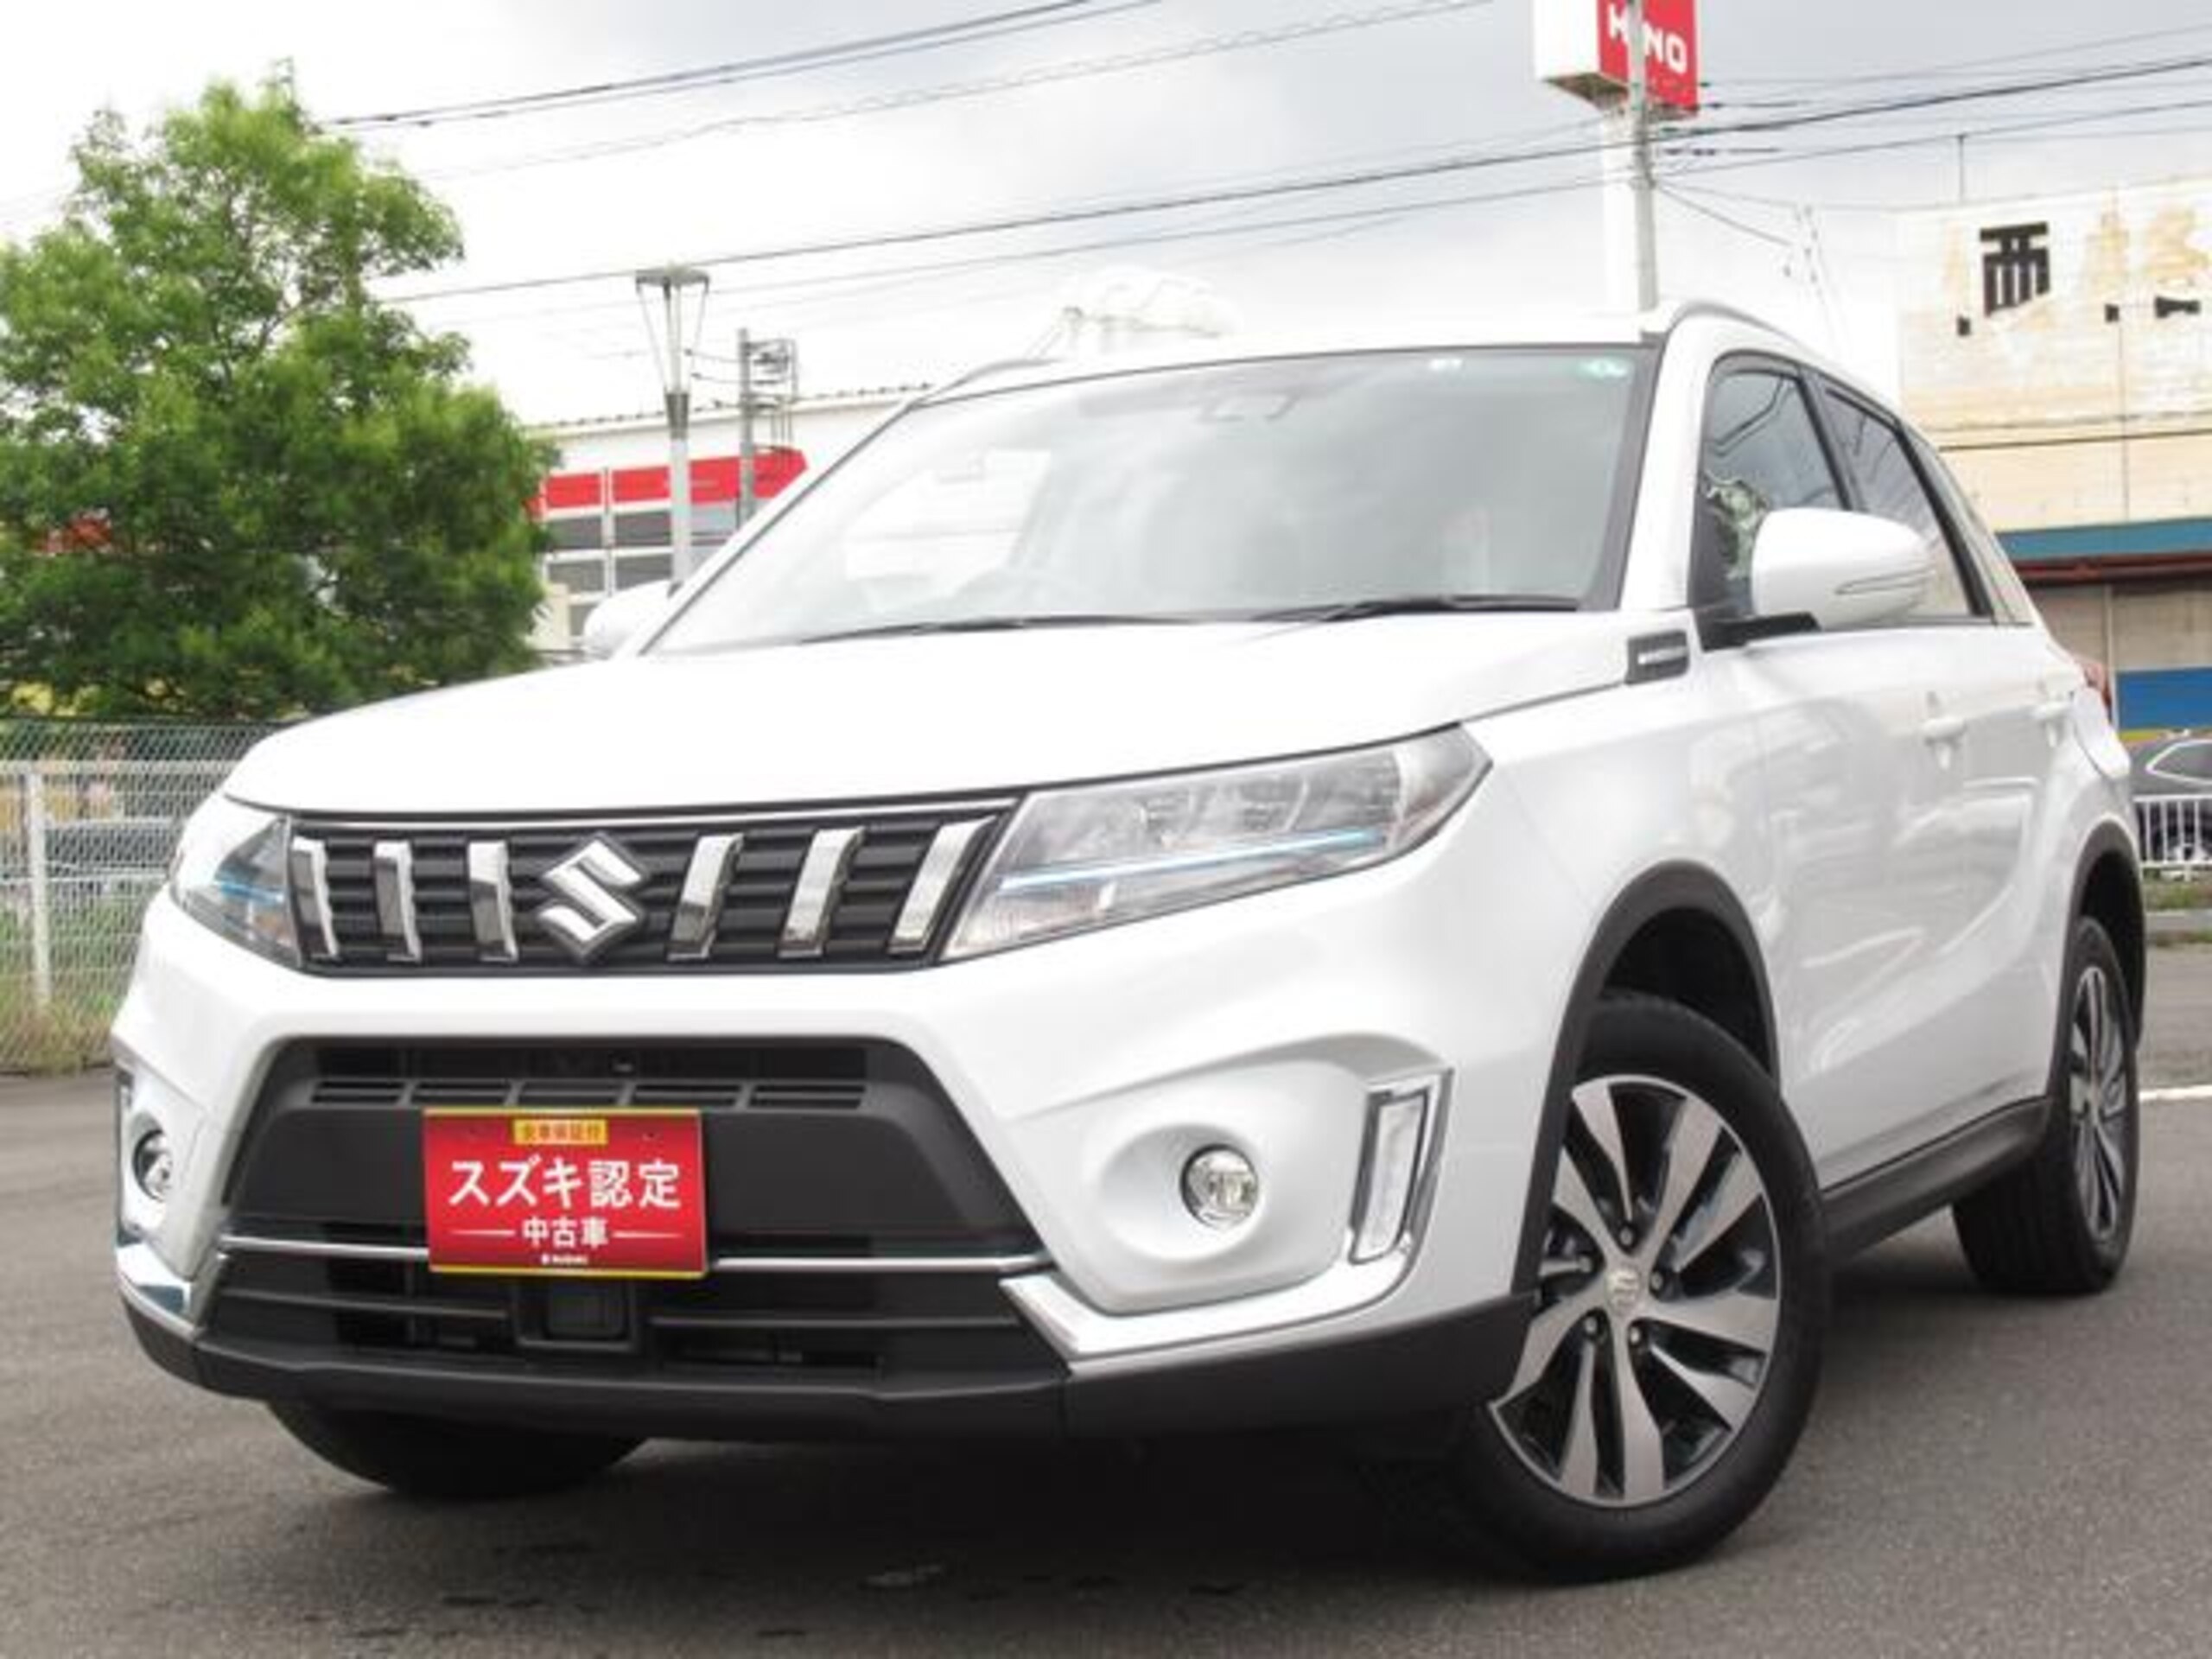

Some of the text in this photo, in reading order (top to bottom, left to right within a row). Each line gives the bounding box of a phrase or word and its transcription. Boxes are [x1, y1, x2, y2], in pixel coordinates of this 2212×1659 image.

[1607, 2, 1688, 74] HNO
[448, 1154, 681, 1209] スズキ認定
[522, 1217, 608, 1249] 中古車
